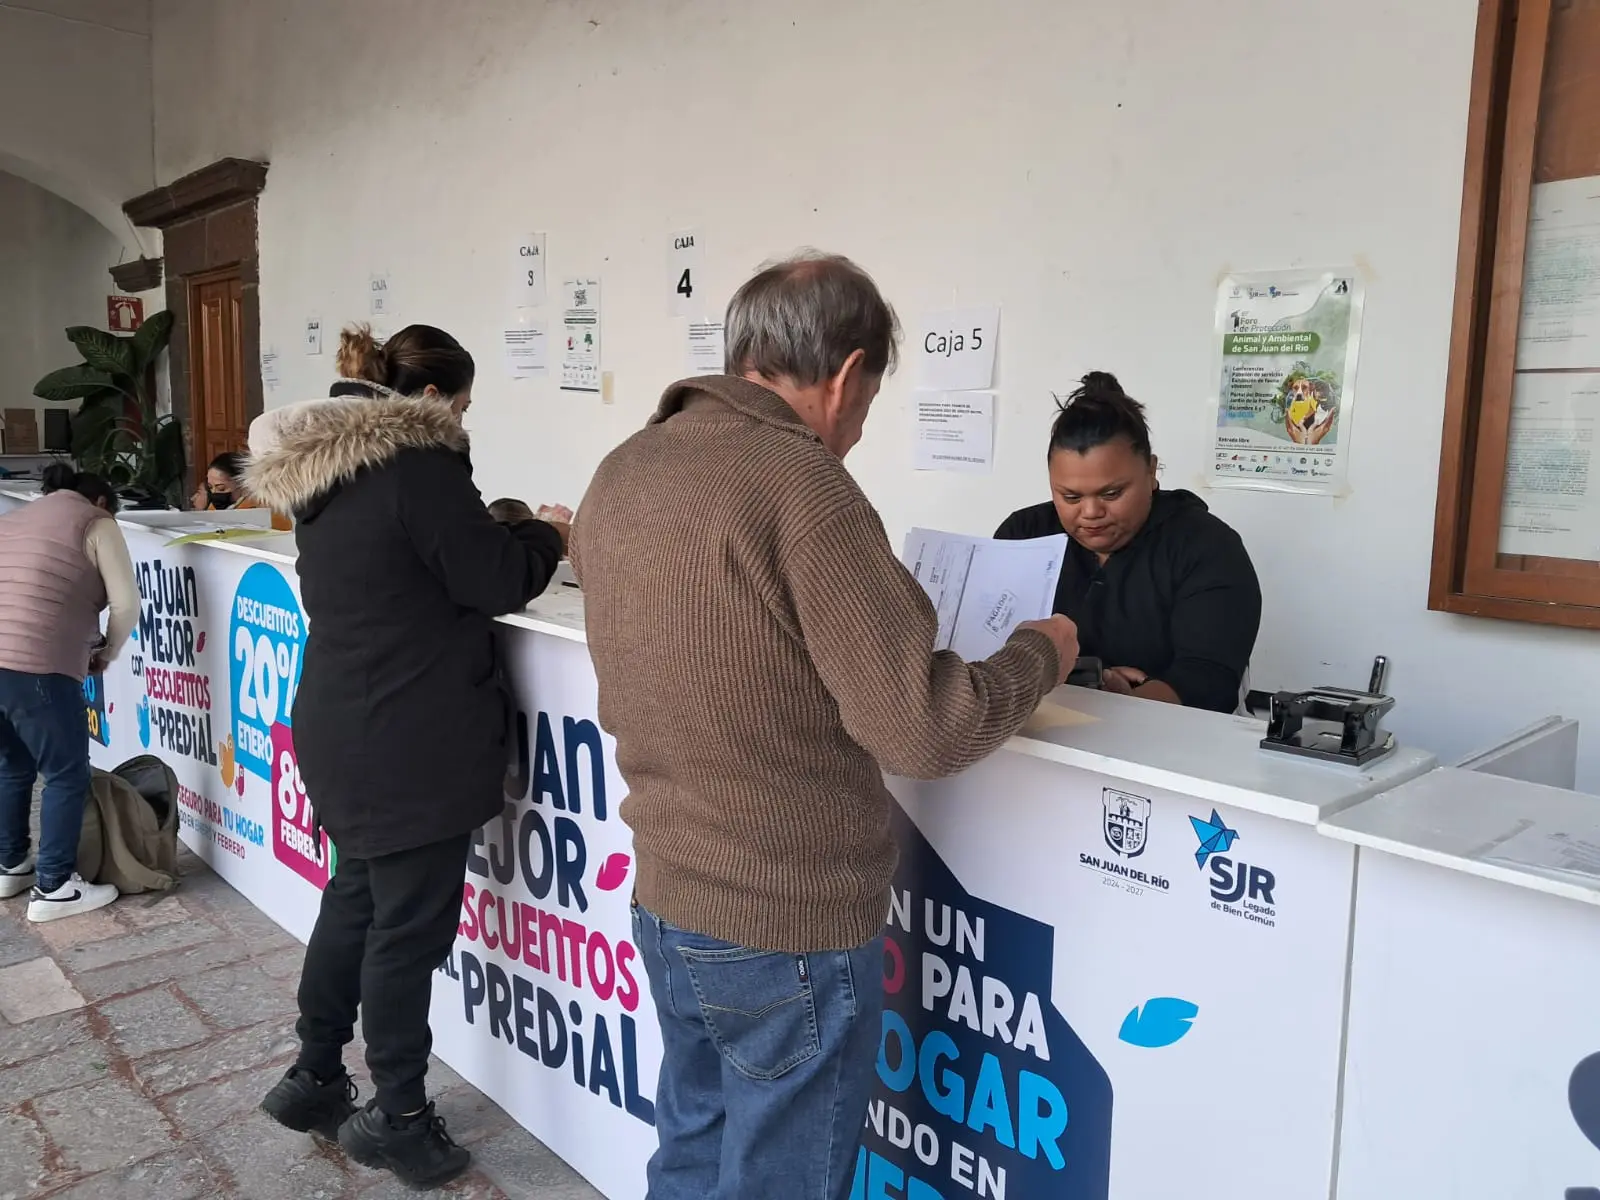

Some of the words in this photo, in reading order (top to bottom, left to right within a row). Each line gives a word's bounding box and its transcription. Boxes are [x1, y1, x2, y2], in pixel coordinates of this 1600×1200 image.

[519, 245, 540, 257] CAJA
[674, 235, 695, 250] CAJA
[527, 270, 534, 286] 3
[676, 267, 693, 299] 4
[1239, 325, 1249, 333] de
[1240, 317, 1258, 325] Foro
[924, 330, 964, 358] Caja
[971, 327, 983, 350] 5
[1231, 345, 1242, 353] de
[1243, 345, 1258, 353] San
[1260, 345, 1279, 353] Juan
[1280, 344, 1294, 352] del
[1232, 335, 1261, 343] Animal
[1262, 336, 1267, 344] y
[1267, 334, 1312, 343] Ambiental
[236, 594, 299, 640] DESCUENTOS
[986, 592, 1009, 627] PAGADO
[237, 718, 274, 766] ENERO
[204, 797, 223, 828] PARA
[222, 806, 234, 832] TU
[235, 812, 265, 848] HOGAR
[216, 832, 246, 860] FEBRERO
[466, 802, 589, 914] EJOR
[1079, 852, 1100, 868] SAN
[1100, 858, 1129, 877] JUAN
[1129, 869, 1150, 884] DEL
[1151, 874, 1170, 890] RÍO
[1209, 855, 1276, 905] SJR
[1102, 876, 1121, 890] 2024
[1126, 885, 1145, 898] 2027
[1210, 900, 1222, 911] de
[1223, 904, 1242, 918] Bien
[1243, 910, 1276, 928] Común
[1242, 899, 1276, 917] Legado
[924, 896, 986, 963] UN
[921, 950, 1051, 1062] PARA
[874, 1008, 1070, 1171] OGAR
[950, 1139, 1008, 1200] EN
